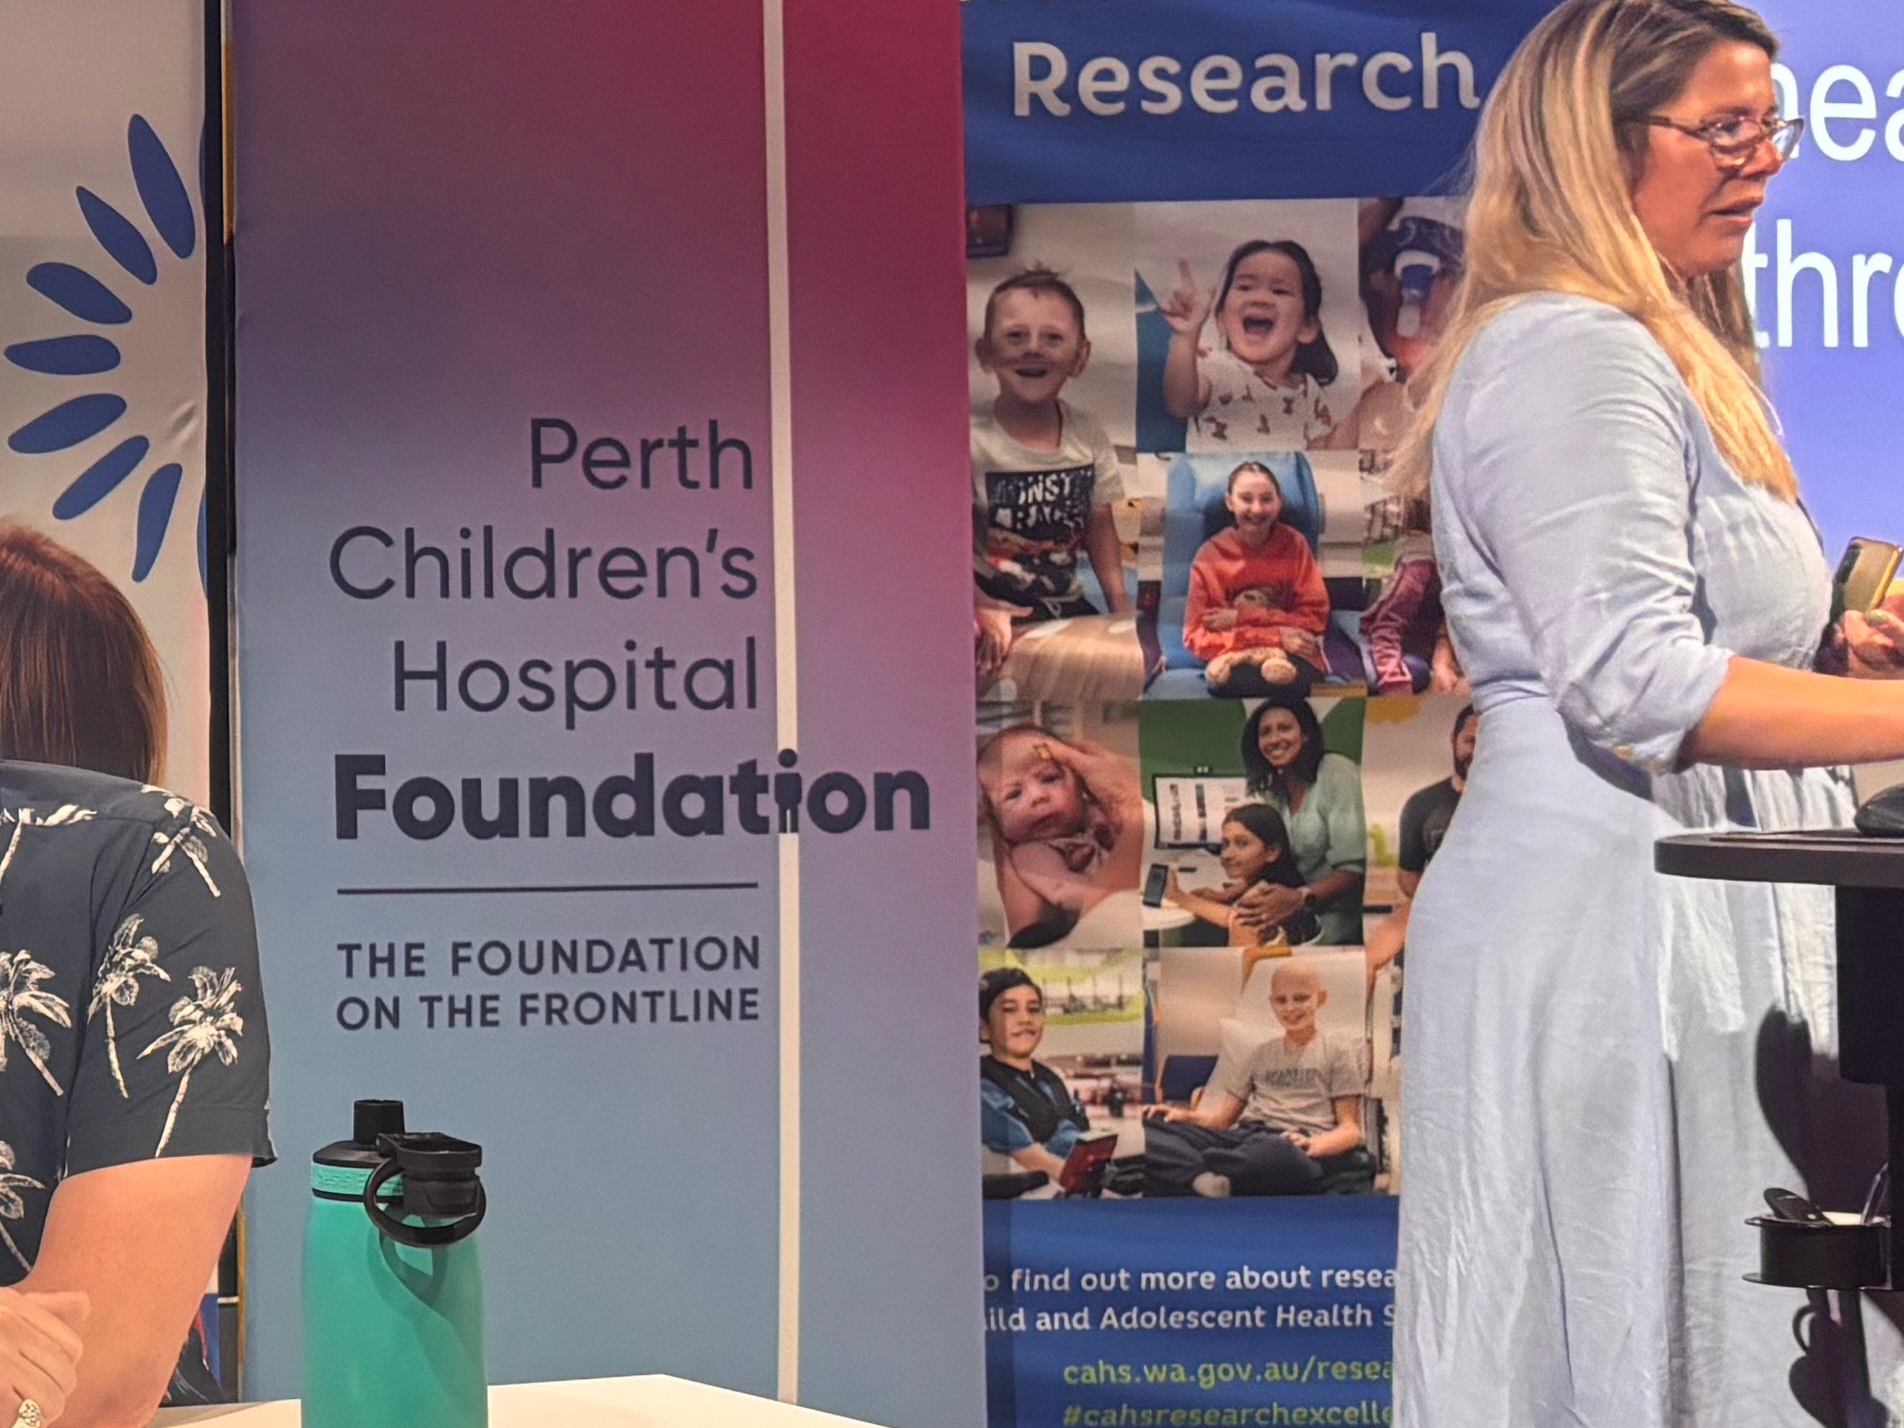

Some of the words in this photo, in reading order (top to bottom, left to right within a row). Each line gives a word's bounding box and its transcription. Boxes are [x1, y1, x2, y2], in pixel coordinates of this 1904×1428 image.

[1012, 32, 1480, 117] Research
[531, 417, 753, 490] Perth
[329, 524, 758, 600] Children's
[394, 635, 757, 731] Hospital
[334, 748, 930, 840] Foundation
[337, 941, 426, 978] THE
[451, 935, 760, 975] FOUNDATION
[336, 996, 400, 1031] ON
[419, 993, 500, 1028] THE
[519, 987, 760, 1026] FRONTLINE
[984, 1276, 999, 1291] o
[1011, 1268, 1070, 1291] find
[1081, 1270, 1130, 1290] out
[1140, 1273, 1215, 1290] more
[1226, 1265, 1310, 1289] about
[985, 1307, 1026, 1332] ild
[1036, 1307, 1090, 1331] and
[1100, 1305, 1265, 1329] Adolescent
[1276, 1304, 1372, 1327] Health
